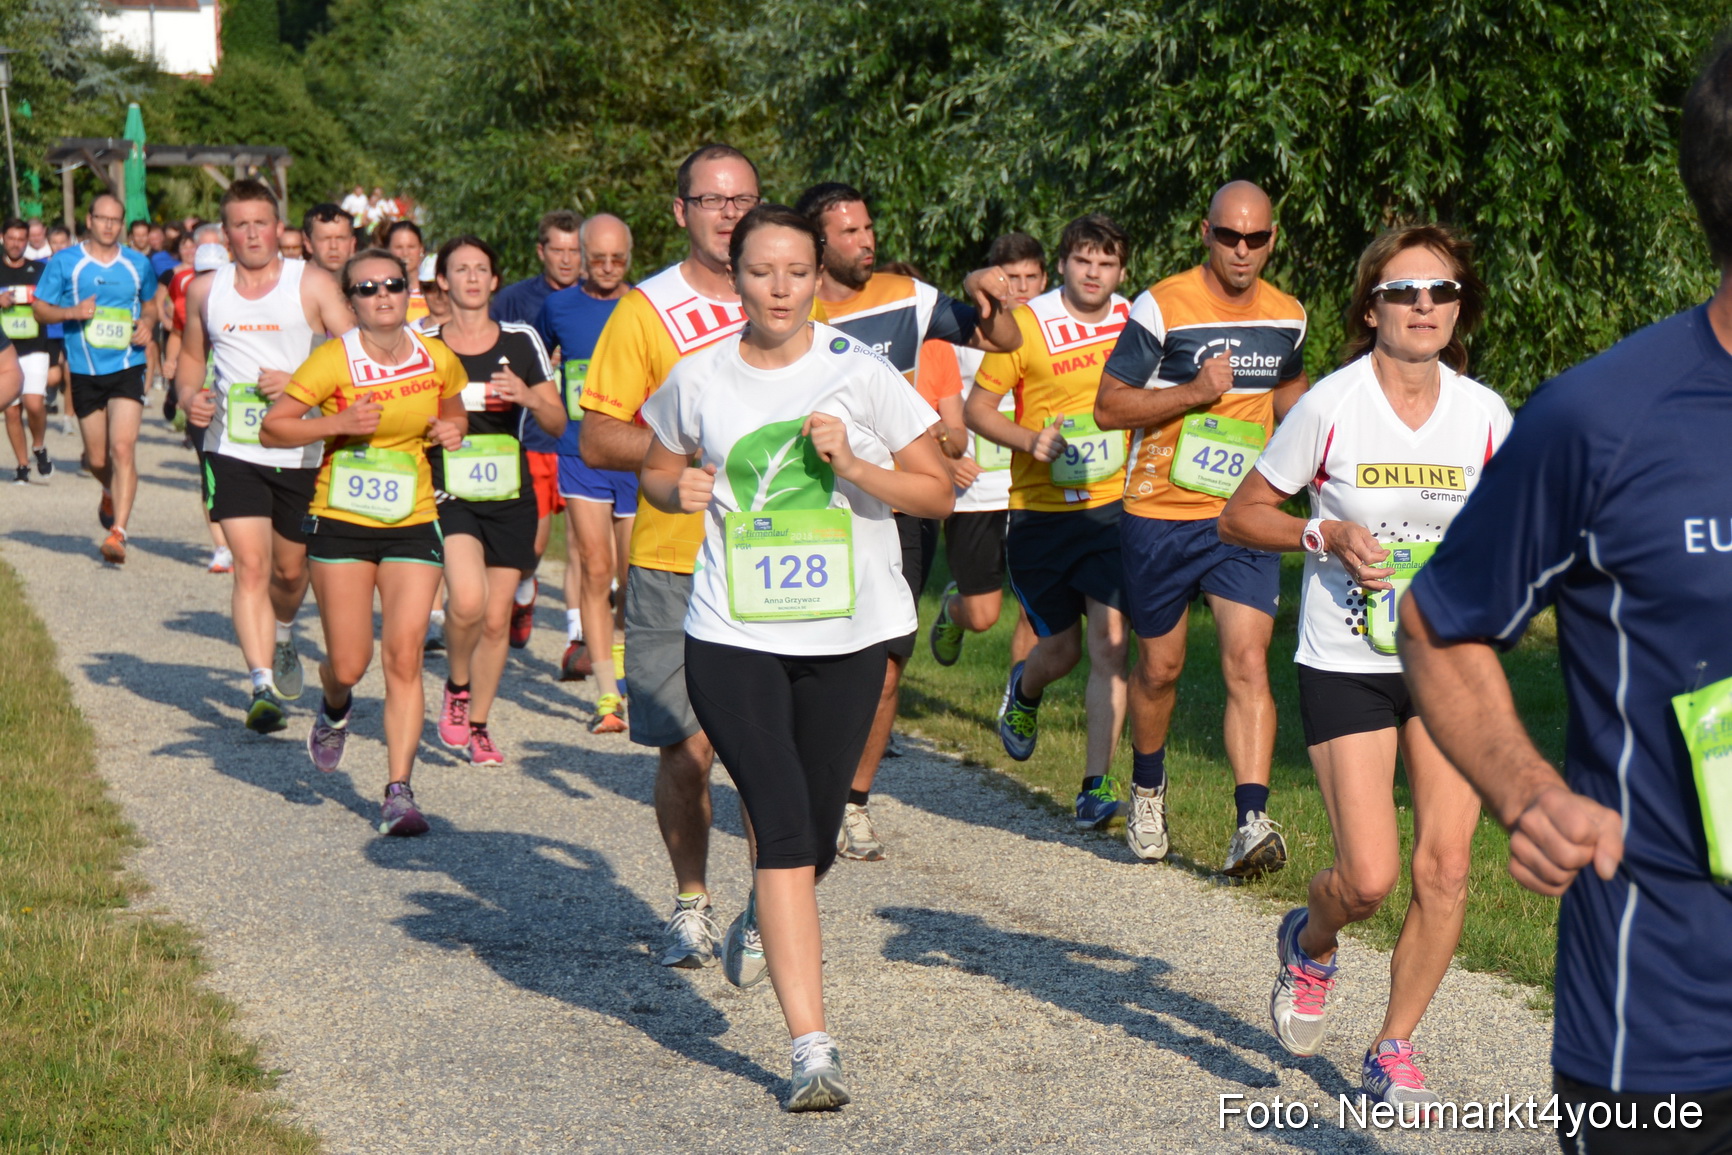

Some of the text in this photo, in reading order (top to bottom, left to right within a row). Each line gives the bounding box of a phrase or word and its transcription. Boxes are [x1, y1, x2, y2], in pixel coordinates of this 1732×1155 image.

[12, 320, 27, 329] 44
[95, 324, 124, 338] 558
[1052, 353, 1098, 376] MAX
[1213, 352, 1282, 367] scher
[1065, 439, 1108, 466] 921
[1192, 446, 1245, 477] 428
[469, 462, 498, 482] 40
[1362, 467, 1458, 486] ONLINE
[348, 475, 398, 502] 938
[1420, 490, 1467, 504] Germany
[746, 528, 789, 538] firmenlauf
[755, 554, 829, 589] 128
[784, 596, 821, 605] Grzywacz
